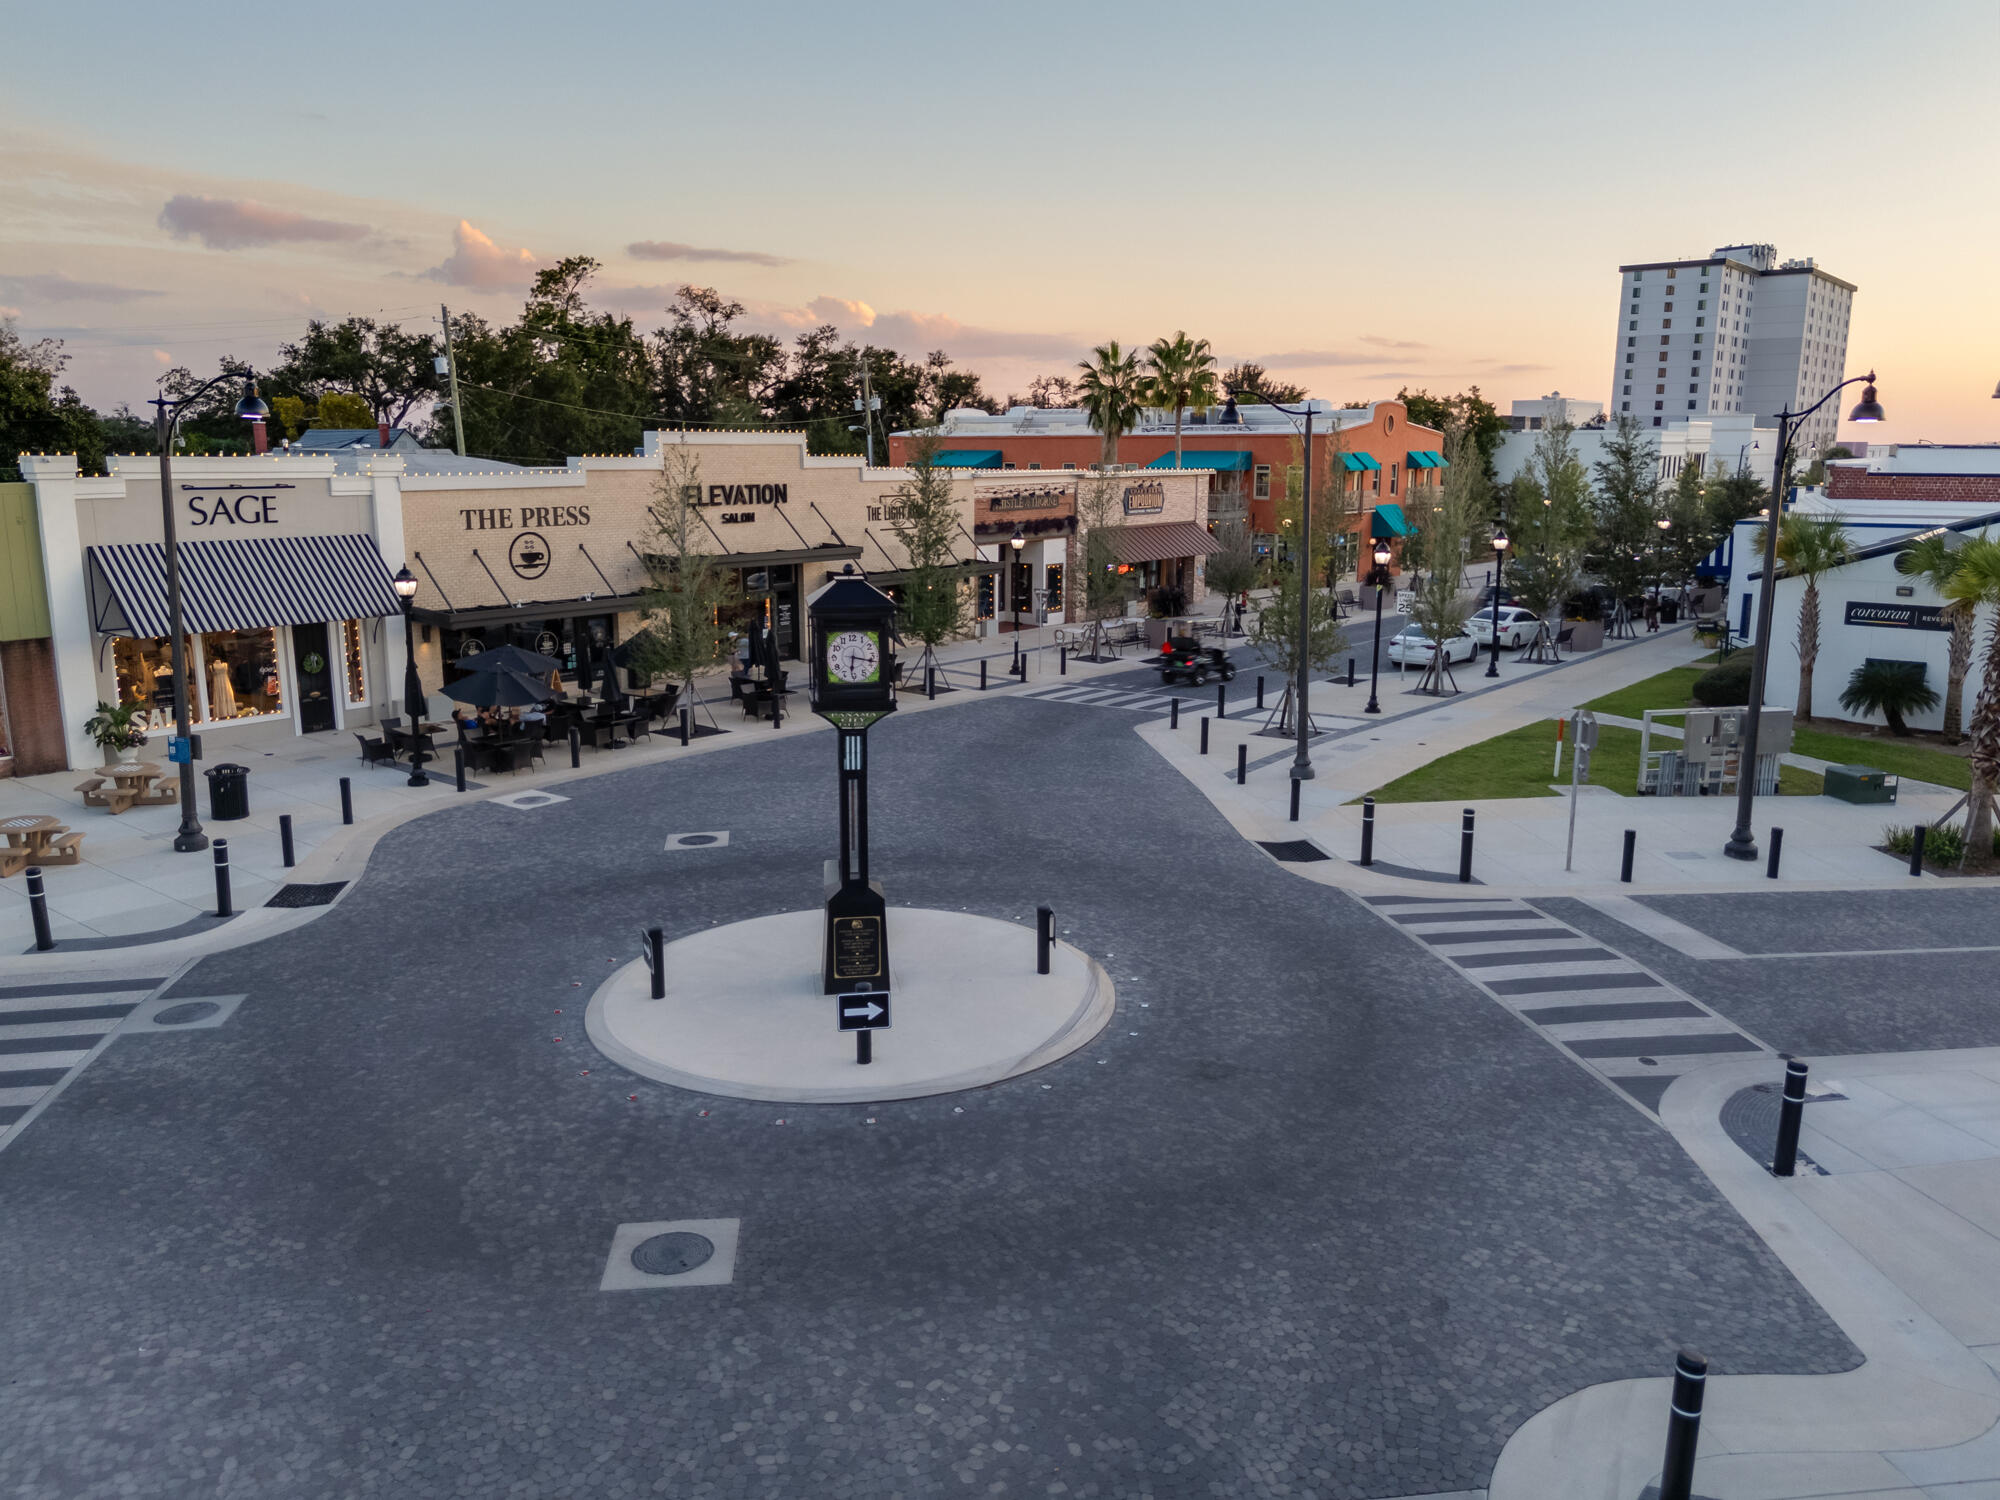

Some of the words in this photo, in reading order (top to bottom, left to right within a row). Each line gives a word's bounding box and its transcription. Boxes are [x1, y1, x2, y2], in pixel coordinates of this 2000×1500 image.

[681, 483, 788, 507] ELEVATION
[188, 495, 279, 525] SAGE
[866, 505, 882, 521] THE
[459, 508, 514, 531] THE
[520, 505, 591, 528] PRESS
[721, 512, 755, 524] SALON
[1398, 603, 1411, 613] 25
[1850, 607, 1911, 620] corcoran
[848, 634, 857, 642] 12
